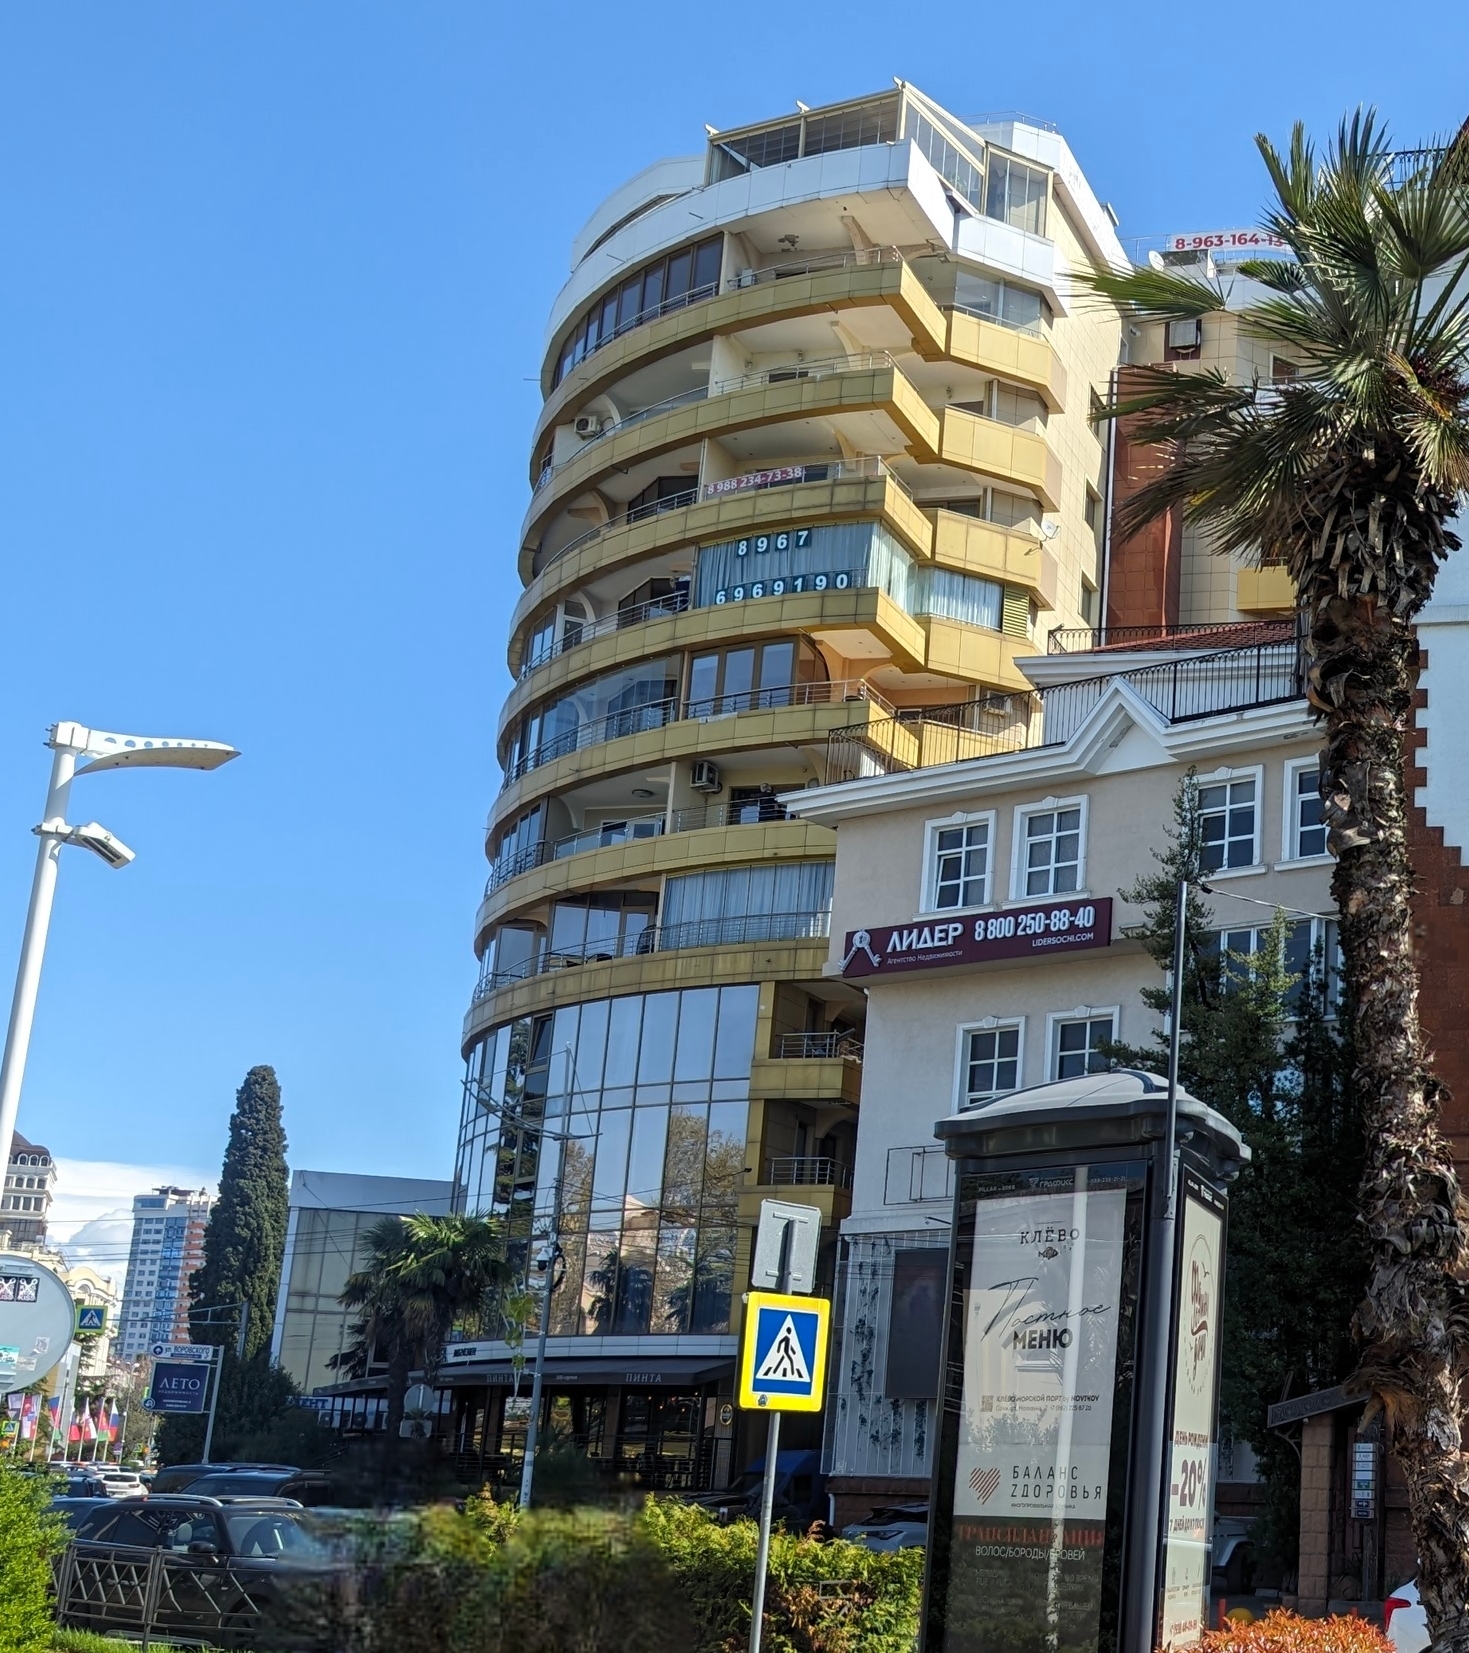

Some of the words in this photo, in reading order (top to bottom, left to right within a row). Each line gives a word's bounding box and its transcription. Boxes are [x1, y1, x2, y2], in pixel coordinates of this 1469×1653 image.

[974, 920, 985, 942] 8
[986, 917, 1015, 941] 800
[1017, 905, 1095, 936] 250-88-40
[886, 922, 965, 953] ЛИДЕР
[1032, 932, 1094, 947] LIDERSOCHI.COM
[1020, 1227, 1080, 1244] КЛЁВО
[1013, 1328, 1074, 1350] МЕНЮ
[626, 1373, 662, 1382] ПИНТА
[1012, 1465, 1078, 1480] БАЛАНС
[1171, 1457, 1207, 1510] -20%
